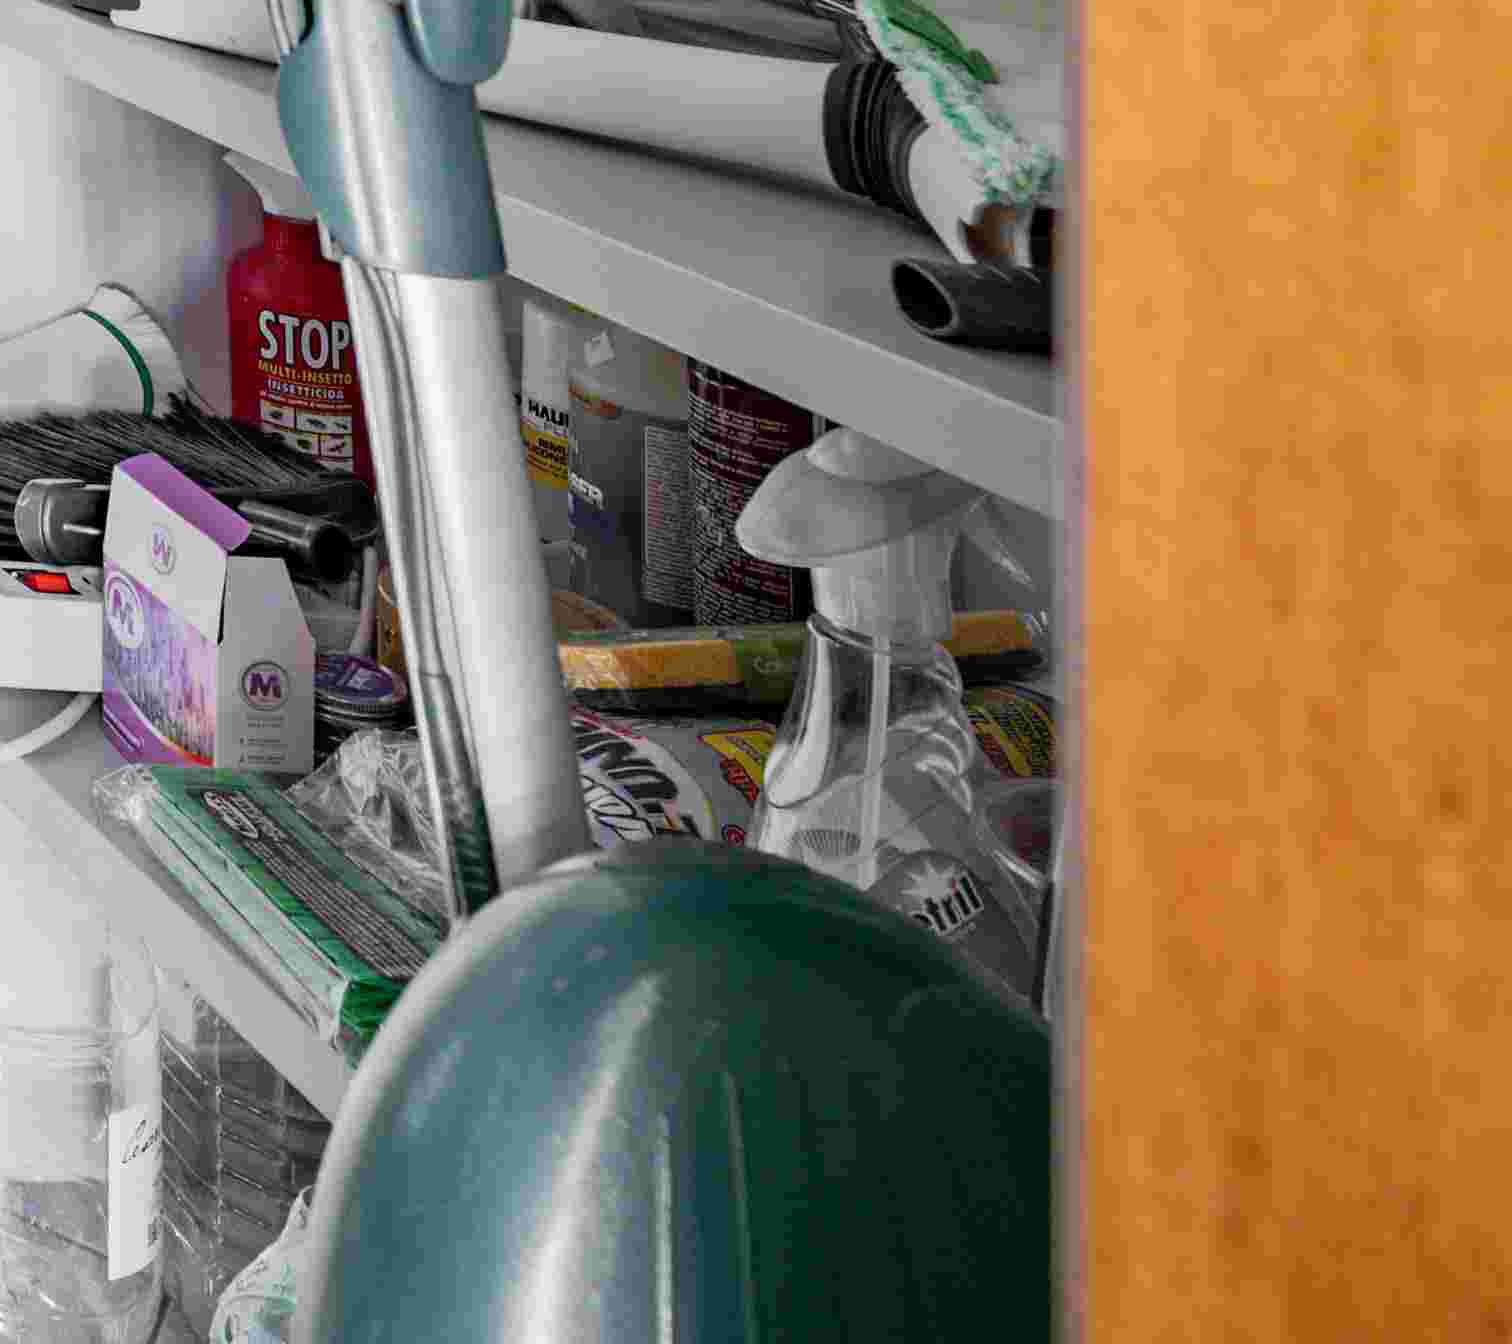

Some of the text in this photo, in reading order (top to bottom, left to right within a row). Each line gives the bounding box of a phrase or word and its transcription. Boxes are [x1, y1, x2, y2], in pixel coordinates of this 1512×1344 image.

[258, 310, 353, 370] STOP
[257, 359, 353, 385] MULTI-INSETTO
[267, 379, 345, 400] INSETTICIDA
[248, 671, 282, 699] M
